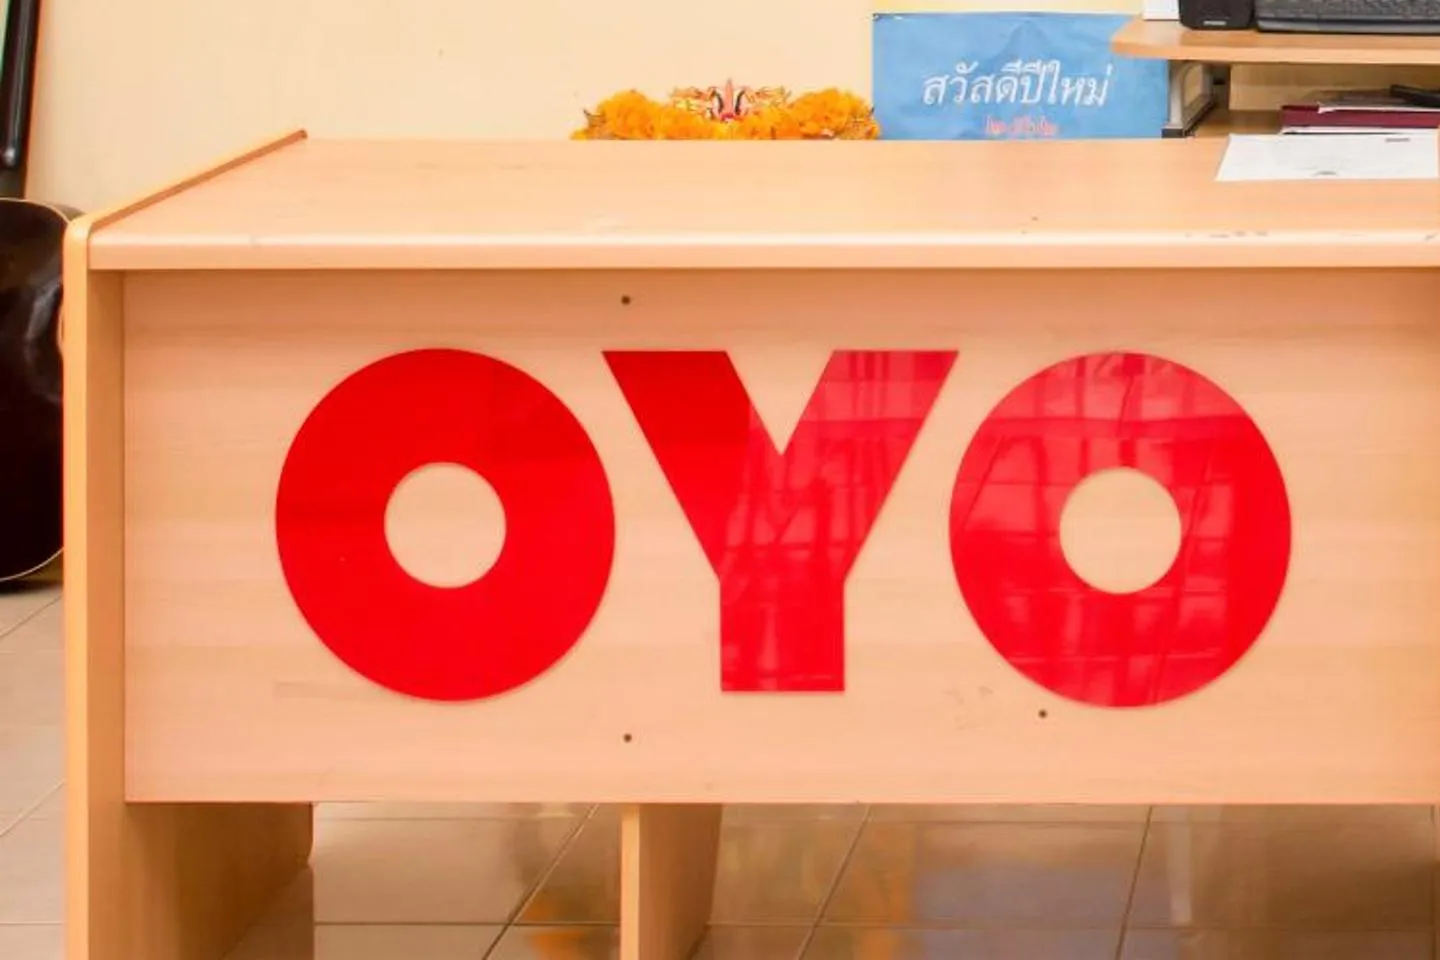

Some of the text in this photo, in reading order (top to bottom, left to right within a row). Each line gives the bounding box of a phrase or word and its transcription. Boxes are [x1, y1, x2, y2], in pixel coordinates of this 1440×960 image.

[922, 59, 1113, 107] สวัสดีปีใหม่
[275, 347, 1292, 708] OYO
